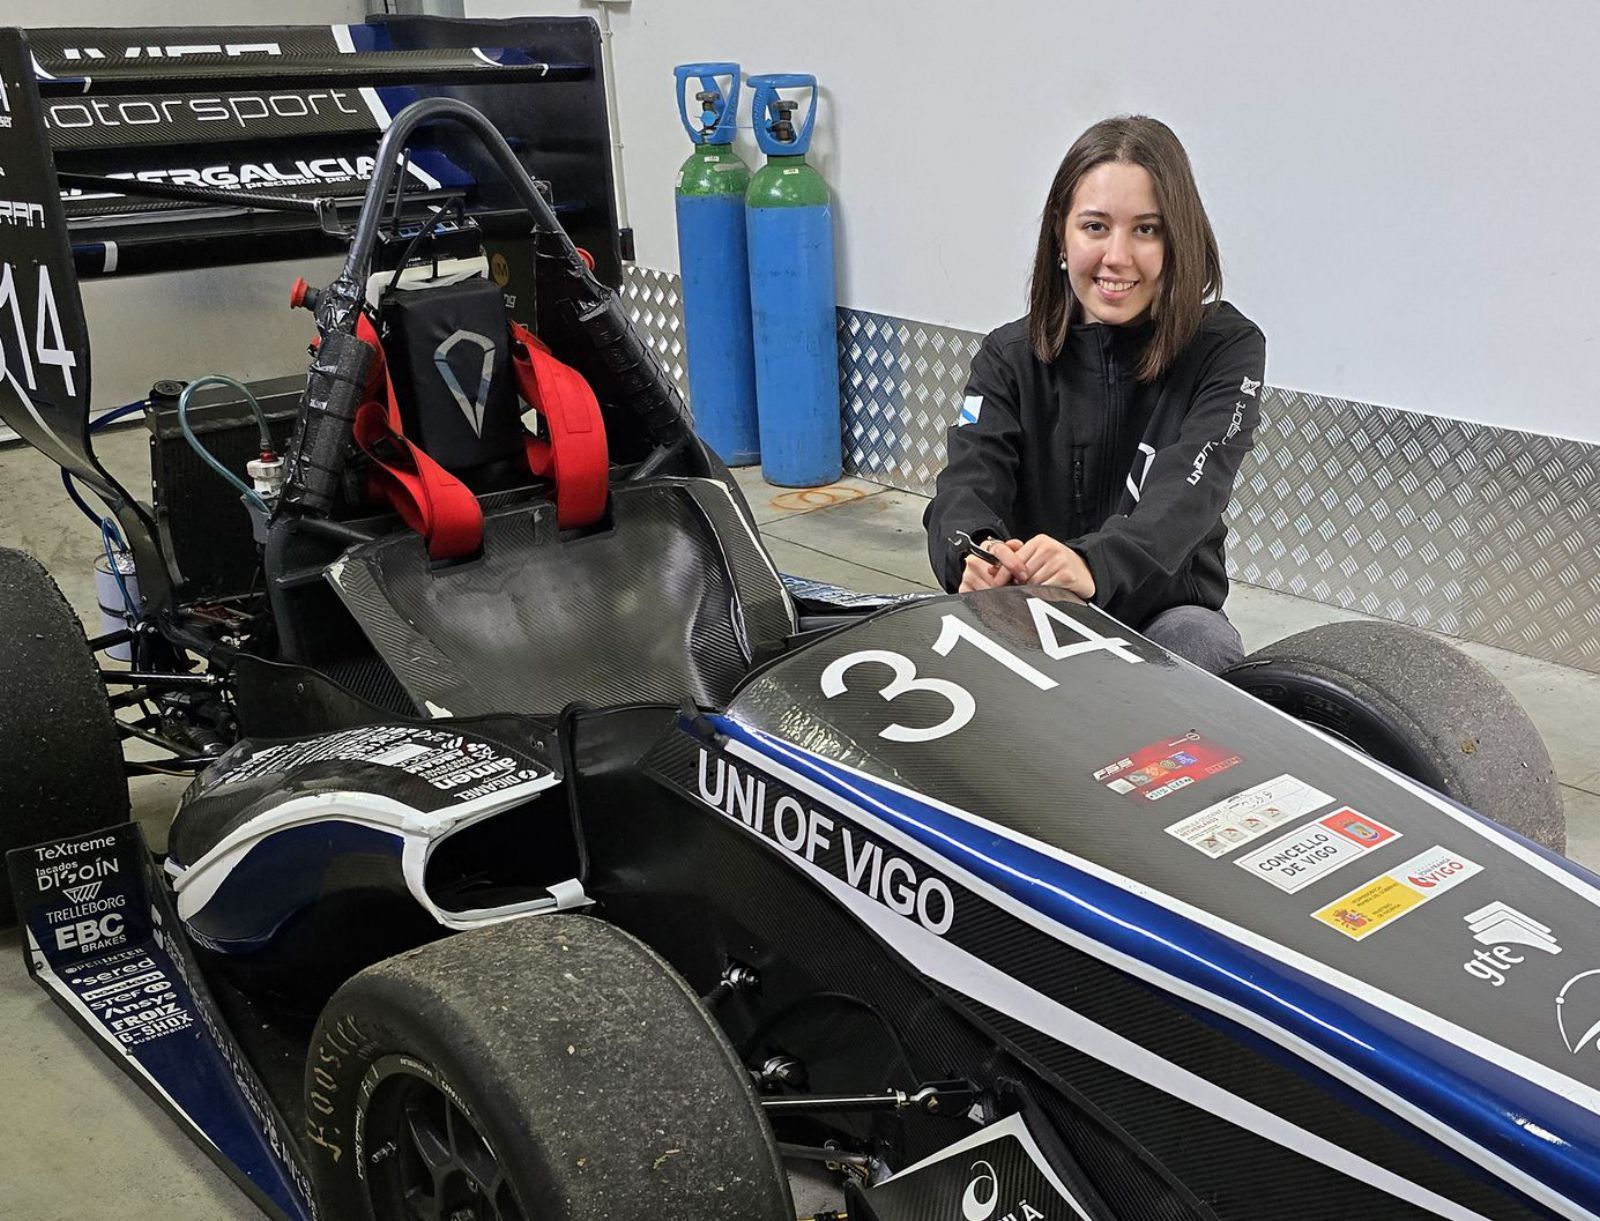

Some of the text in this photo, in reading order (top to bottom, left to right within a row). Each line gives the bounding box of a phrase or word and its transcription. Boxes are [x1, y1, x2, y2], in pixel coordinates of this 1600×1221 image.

[44, 88, 358, 128] otorsport
[105, 156, 376, 188] ERGALICIA
[0, 261, 77, 397] 14
[820, 597, 1145, 743] 314
[453, 774, 522, 801] DIGAMEL
[35, 836, 116, 861] TeXtreme
[698, 748, 954, 935] UNI OF VIGO
[1258, 833, 1329, 872] CONCELLO
[36, 861, 78, 877] lacados
[1280, 845, 1338, 877] DE VIGO
[1425, 860, 1465, 883] VIGO
[45, 894, 126, 925] TRELLEBORG
[55, 913, 125, 951] EBC
[81, 934, 127, 954] BRAKES
[83, 957, 156, 986] sered
[1463, 945, 1525, 987] gte
[105, 991, 177, 1020] Ansys
[111, 1002, 181, 1031] FROIZ
[119, 1013, 194, 1043] G-SHOX
